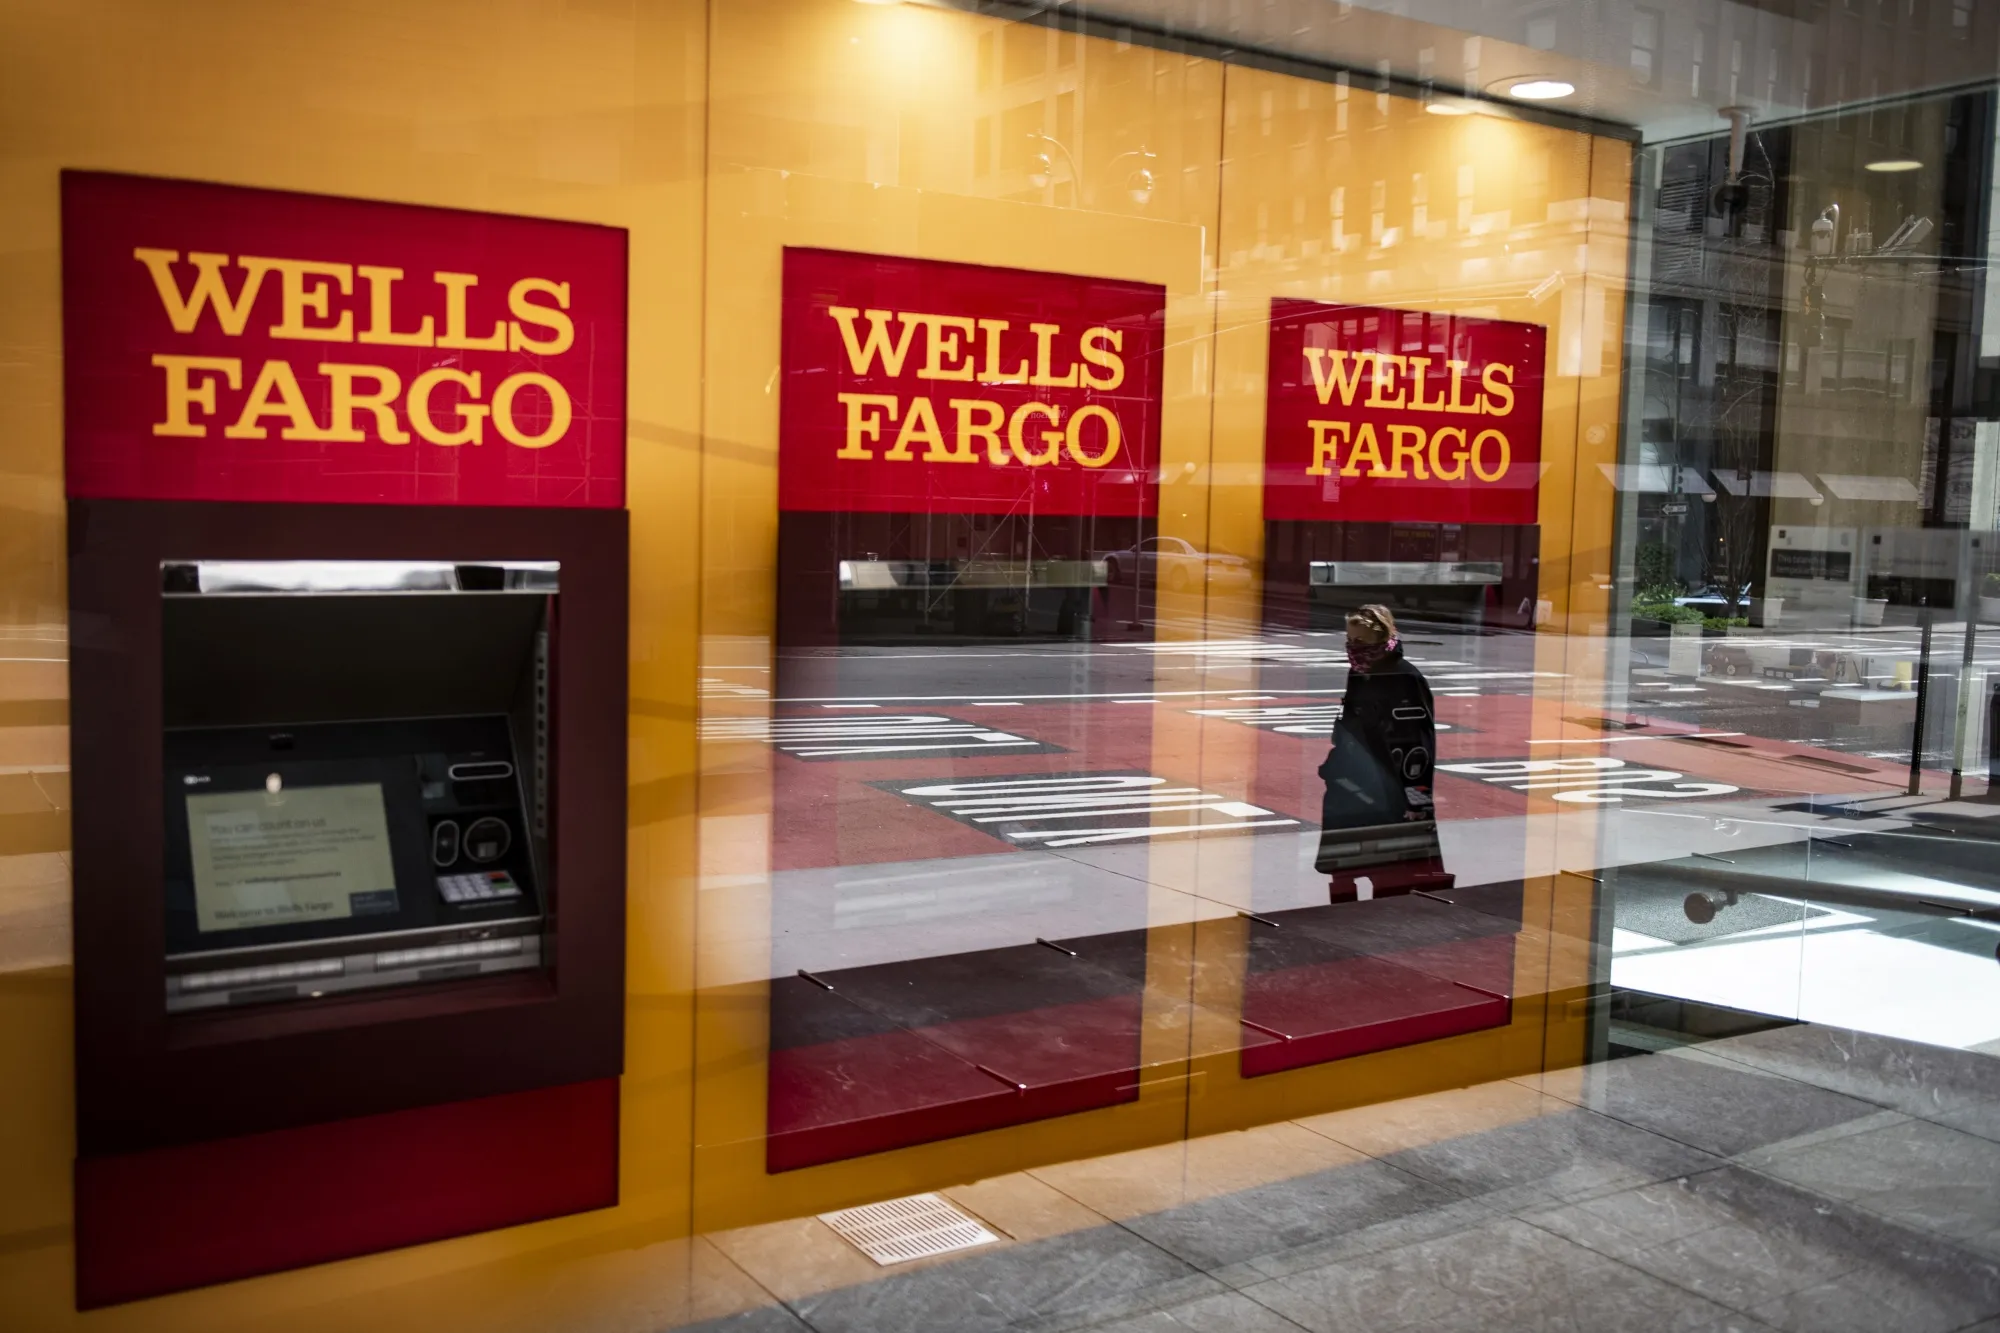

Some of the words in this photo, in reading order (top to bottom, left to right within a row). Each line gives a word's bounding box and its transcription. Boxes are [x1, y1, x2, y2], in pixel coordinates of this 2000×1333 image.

[133, 247, 574, 355] WELLS
[828, 305, 1126, 391] WELLS
[1302, 346, 1515, 417] WELLS
[152, 354, 573, 449] FARGO
[836, 392, 1122, 468] FARGO
[1305, 419, 1512, 483] FARGO
